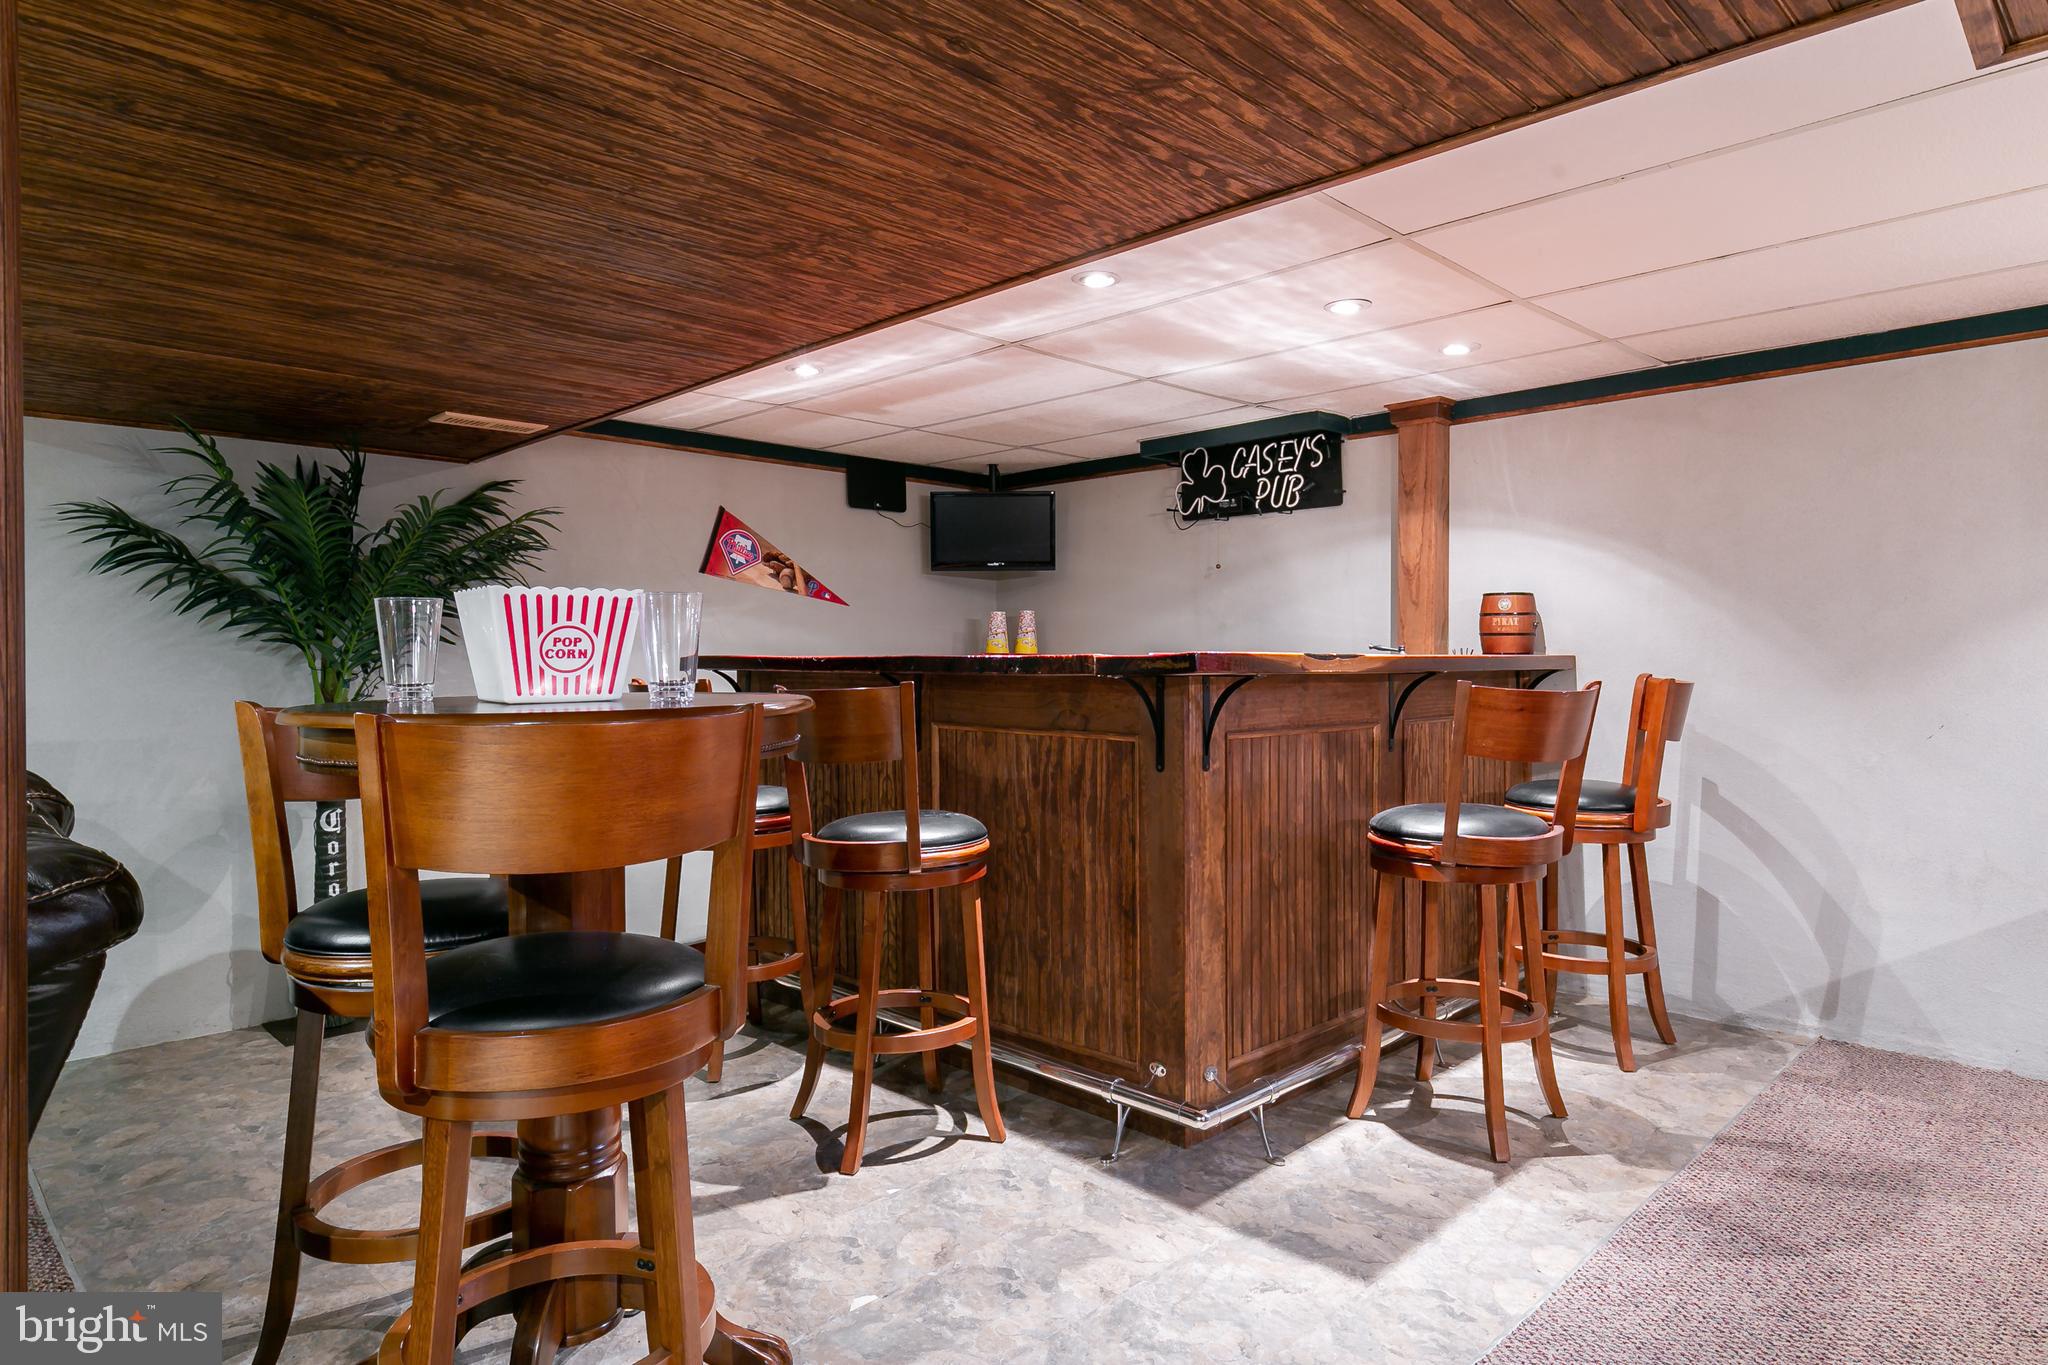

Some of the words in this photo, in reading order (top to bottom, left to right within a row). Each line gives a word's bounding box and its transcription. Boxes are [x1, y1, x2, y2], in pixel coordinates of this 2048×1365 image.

[1230, 433, 1326, 479] CASEY'S
[1255, 473, 1305, 509] PUB
[544, 648, 588, 659] CORN
[552, 637, 582, 647] POP
